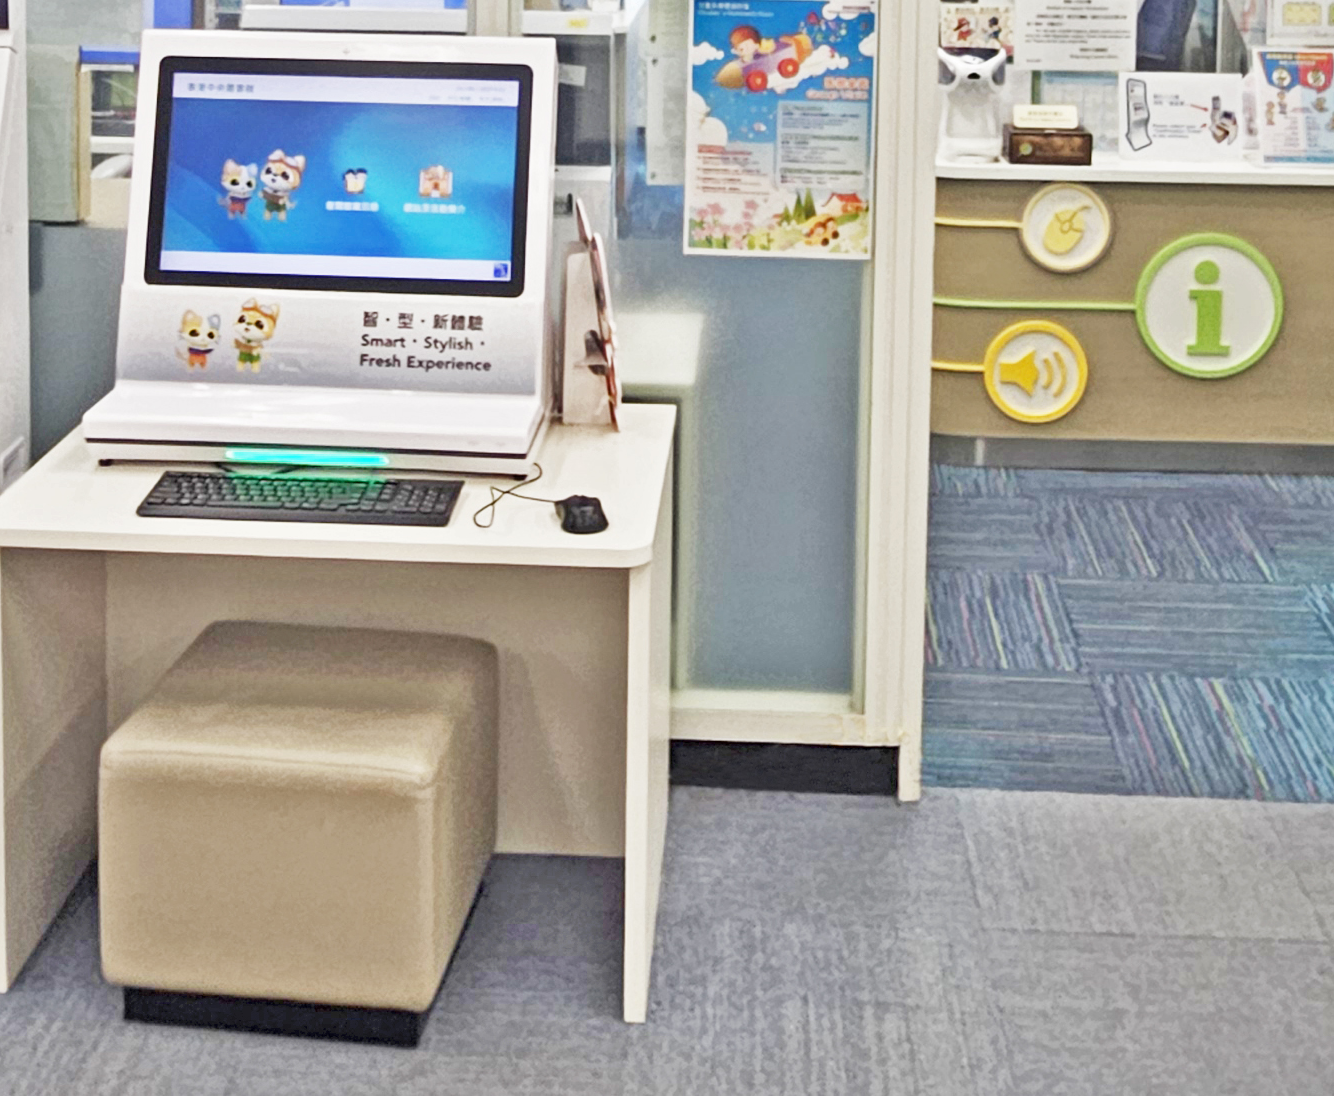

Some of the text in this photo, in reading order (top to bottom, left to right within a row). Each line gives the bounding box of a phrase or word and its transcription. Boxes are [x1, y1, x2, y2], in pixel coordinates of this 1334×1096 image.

[360, 333, 474, 353] Smart Stylish
[359, 353, 492, 373] Fresh Experience
